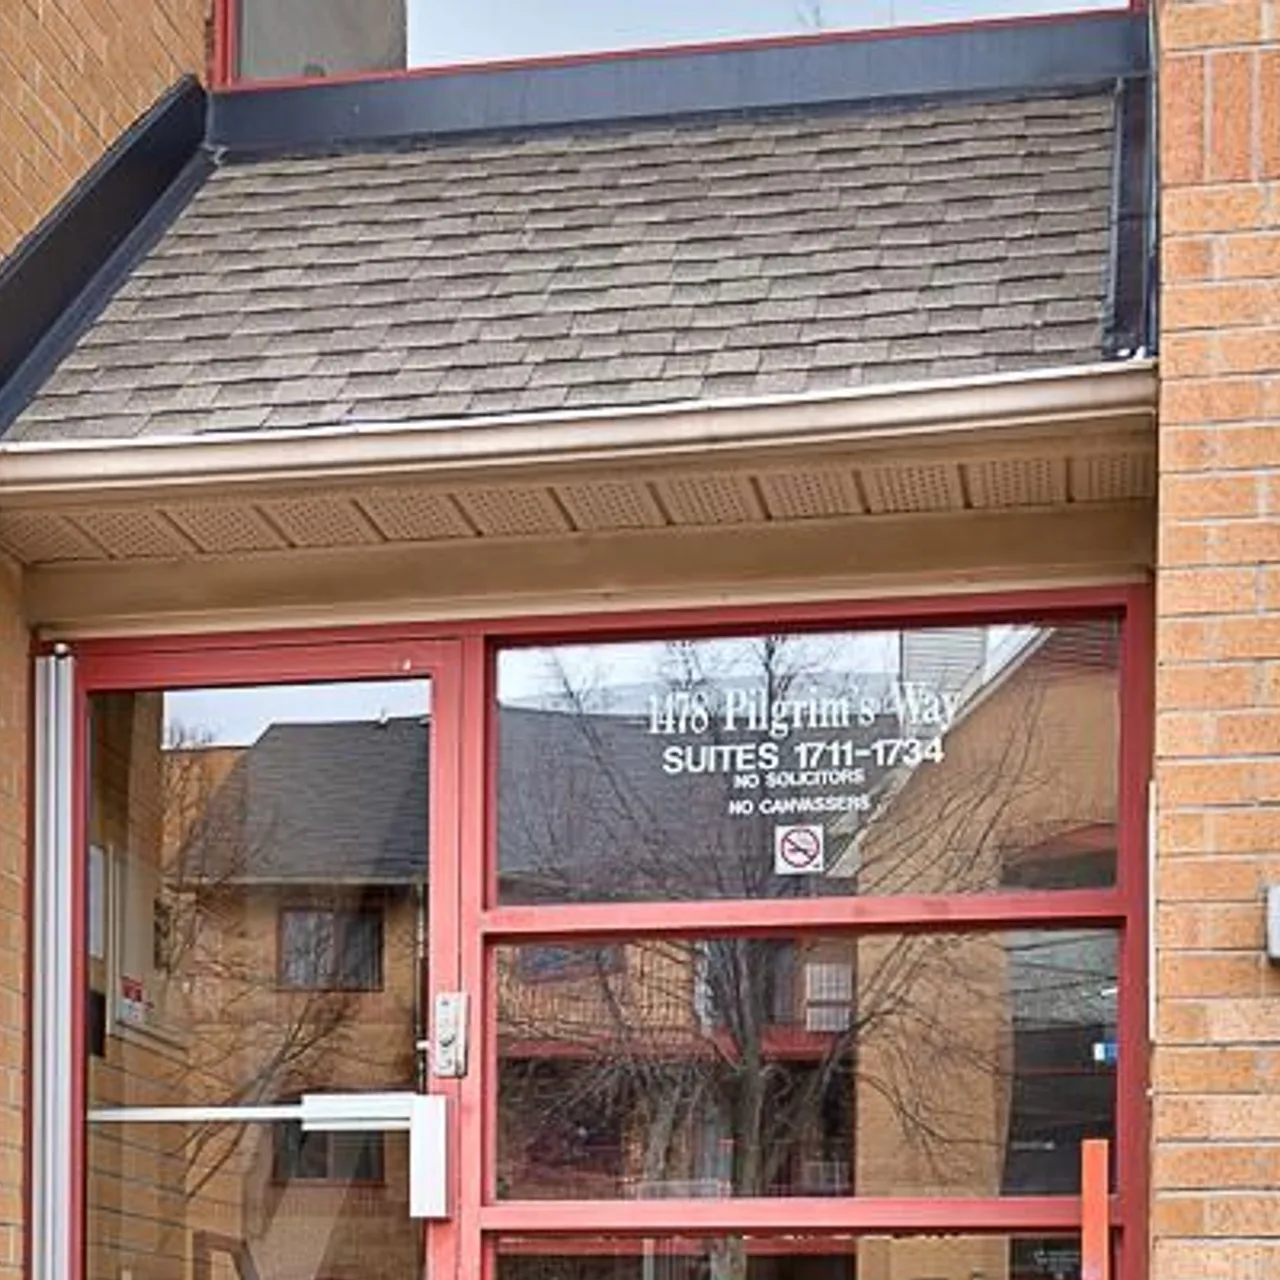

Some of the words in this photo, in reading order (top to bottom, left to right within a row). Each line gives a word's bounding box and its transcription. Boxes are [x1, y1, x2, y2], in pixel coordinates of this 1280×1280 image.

[722, 686, 875, 738] Pilgrim's
[884, 681, 962, 730] Way
[662, 742, 779, 773] SUITES
[793, 737, 945, 769] 1711-1734
[733, 773, 760, 789] NO
[765, 768, 866, 788] SOLICITORS
[729, 799, 754, 815] NO
[759, 793, 870, 814] CANVASSERS
